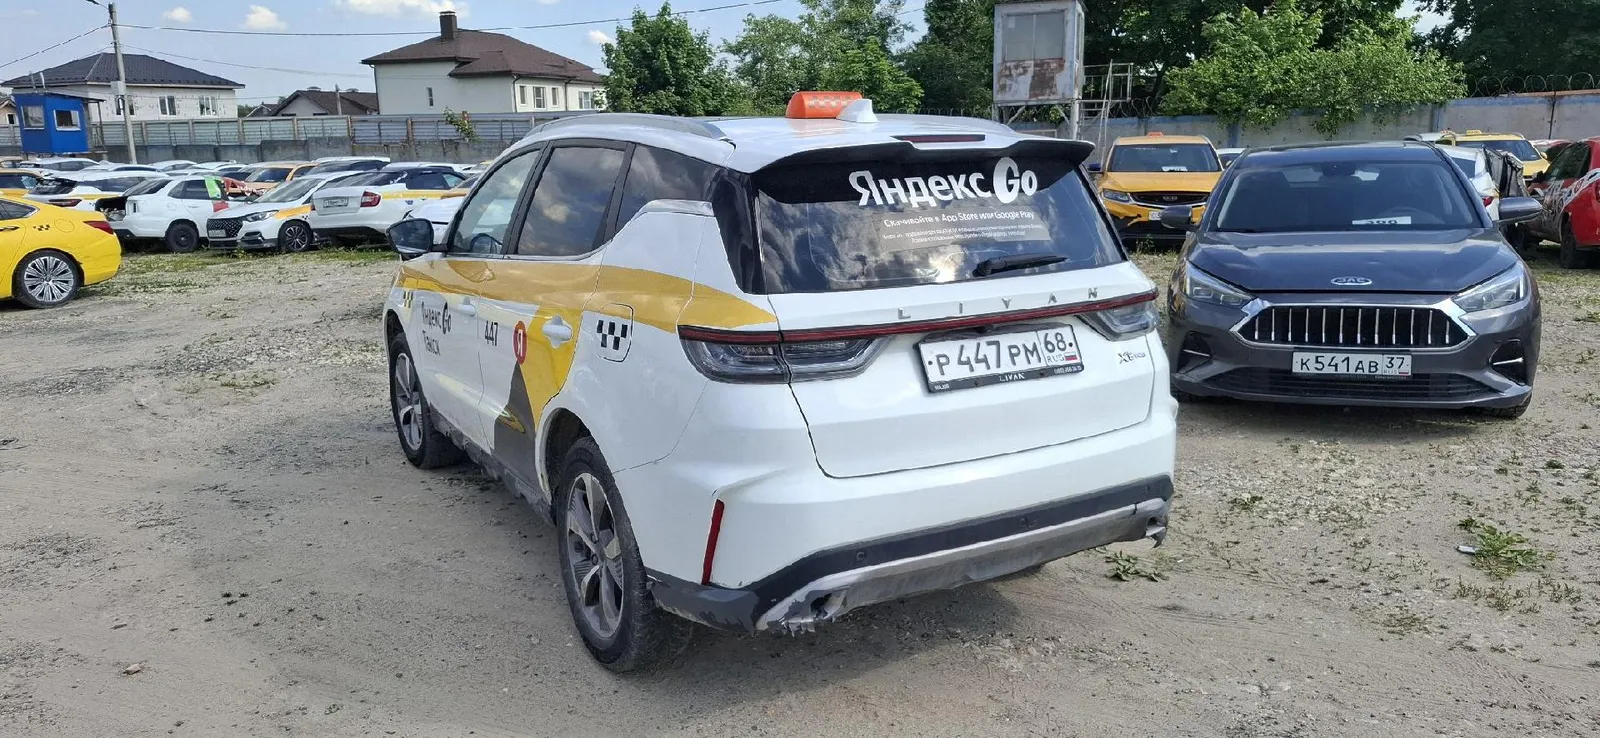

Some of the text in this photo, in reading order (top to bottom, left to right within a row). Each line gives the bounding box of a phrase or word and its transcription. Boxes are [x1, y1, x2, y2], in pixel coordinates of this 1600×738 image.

[849, 157, 1038, 208] Яндекс Go
[941, 213, 958, 222] App
[957, 212, 979, 221] Store
[994, 210, 1019, 220] Google
[1020, 210, 1035, 220] Play
[442, 301, 452, 335] Go
[484, 320, 499, 347] 447
[1043, 332, 1067, 353] 68
[1385, 356, 1405, 370] 37
